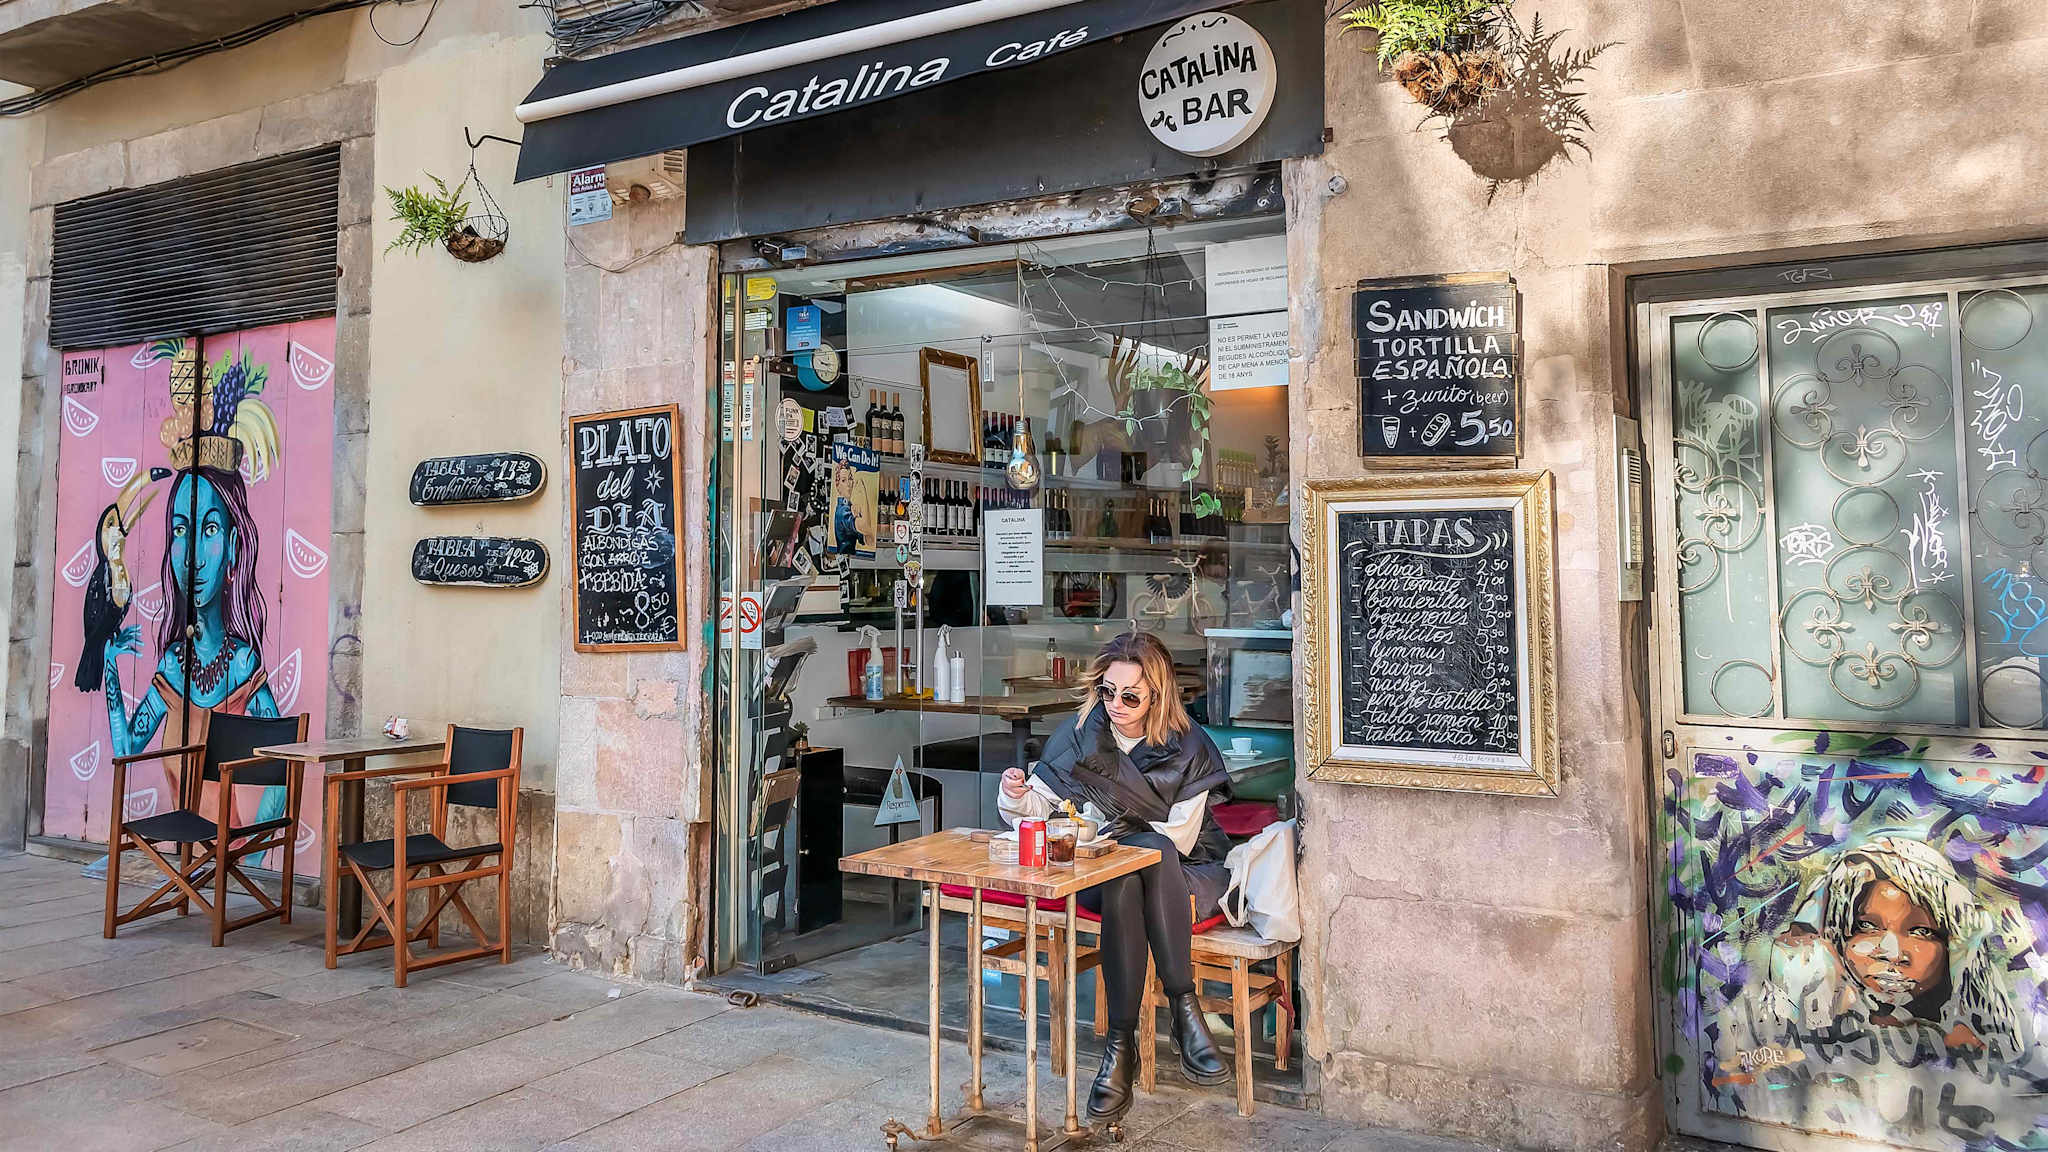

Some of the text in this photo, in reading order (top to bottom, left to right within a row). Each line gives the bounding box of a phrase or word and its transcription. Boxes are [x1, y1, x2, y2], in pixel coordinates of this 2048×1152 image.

[726, 26, 1089, 129] Catalina Café
[1141, 41, 1257, 99] CATALINA
[1182, 88, 1253, 125] BAR
[1366, 299, 1504, 333] SANDWICH
[1372, 335, 1501, 357] TORTILLA
[1372, 355, 1512, 380] ESPAÑOLA
[1400, 384, 1472, 414] zurito
[1469, 388, 1509, 407] (beer)
[1455, 409, 1513, 446] 5,50
[579, 417, 672, 469] PLATO
[835, 444, 847, 460] We
[848, 447, 861, 463] Can
[861, 450, 870, 465] Do
[424, 460, 466, 476] TABLA
[422, 476, 492, 500] Embutidos
[596, 466, 635, 502] del
[585, 498, 669, 535] DIA
[1370, 517, 1476, 548] TAPAS
[427, 540, 476, 557] TABLA
[582, 553, 606, 568] CON
[434, 556, 484, 582] Quesos
[1365, 555, 1425, 577] olivas
[1364, 577, 1399, 595] pan
[1402, 571, 1466, 592] tomate
[1367, 590, 1472, 610] banderilla
[1369, 608, 1469, 629] boquerones
[1367, 625, 1456, 644] choricitos
[1370, 641, 1445, 661] hummus
[1370, 658, 1434, 677] bravas
[1369, 676, 1431, 693] nachos
[1365, 691, 1428, 712] pincho
[1426, 687, 1495, 711] tortilla
[1361, 709, 1420, 725] tabla
[1417, 713, 1483, 732] jamón
[1361, 725, 1415, 743] tabla
[1421, 727, 1478, 745] mixta
